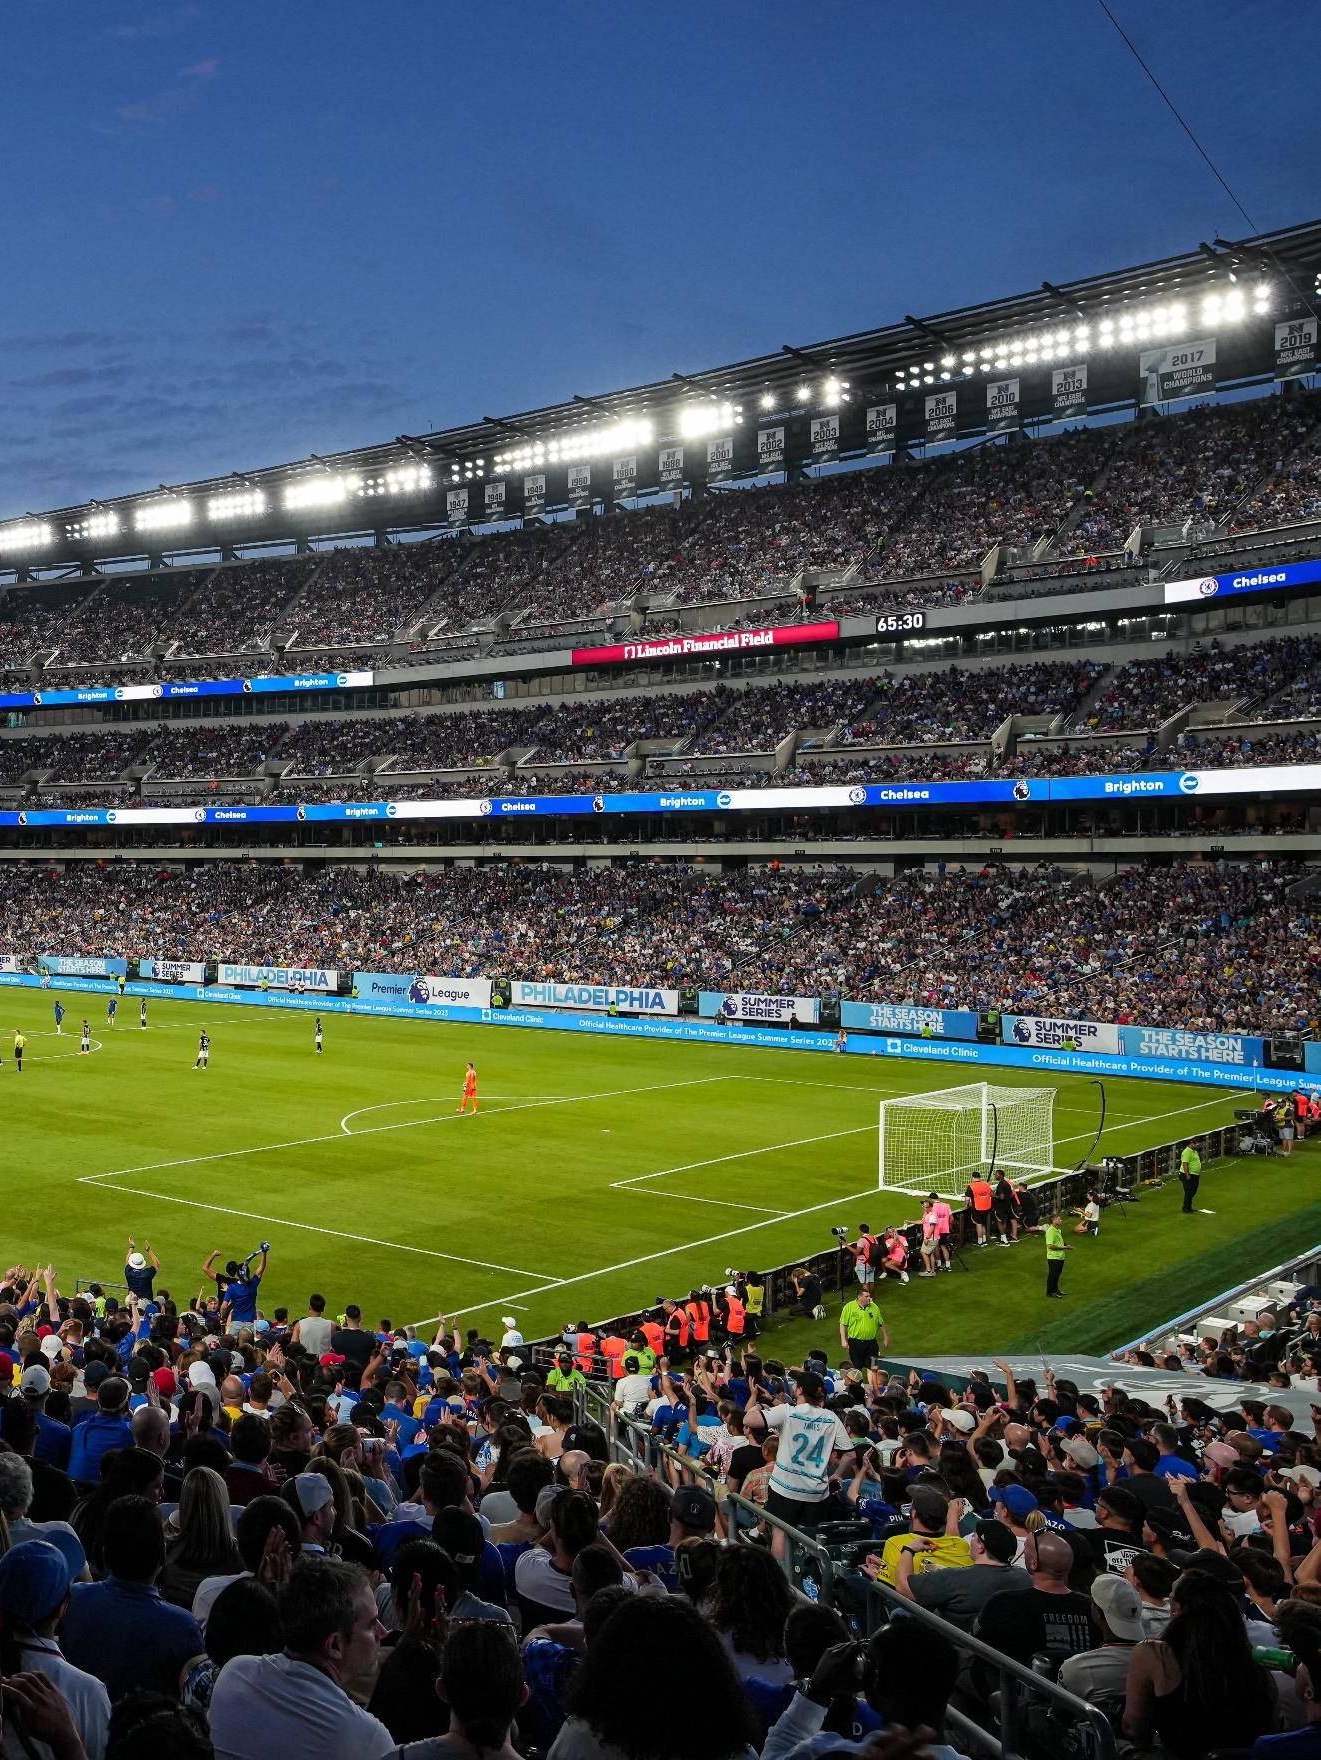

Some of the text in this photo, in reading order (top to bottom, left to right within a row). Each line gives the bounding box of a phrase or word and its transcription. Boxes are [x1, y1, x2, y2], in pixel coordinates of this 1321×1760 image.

[1280, 332, 1311, 348] 2019
[1172, 350, 1204, 366] 2017
[1277, 352, 1314, 364] CHAMPIONS
[1280, 350, 1292, 358] NFC
[1173, 368, 1202, 380] WORLD
[1056, 380, 1082, 393] 2013
[1164, 373, 1212, 390] CHAMPIONS
[991, 392, 1015, 405] 2010
[1054, 397, 1085, 408] CHAMPIONS
[928, 406, 954, 418] 2006
[869, 417, 893, 429] 2004
[814, 428, 836, 440] 2003
[761, 440, 782, 451] 2002
[710, 449, 730, 461] 2001
[527, 485, 544, 495] 1949
[488, 493, 503, 501] 1948
[1233, 572, 1286, 588] Chelsea
[877, 614, 923, 632] 65:30
[637, 631, 774, 658] Lincoln Financial Field
[78, 692, 107, 701] Brighton
[294, 679, 328, 687] Brighton
[67, 814, 98, 822] Brighton
[346, 808, 378, 817] Brighton
[502, 802, 536, 811] Chelsea
[660, 797, 705, 808] Brighton
[880, 790, 929, 800] Chelsea
[1104, 781, 1163, 794] Brighton
[162, 963, 191, 972] SUMMER
[224, 967, 328, 986] PHILADELPHIA
[371, 982, 470, 1002] Premier League
[520, 984, 666, 1010] PHILADELPHIA
[286, 998, 312, 1006] Healthcare
[741, 997, 795, 1009] SUMMER
[492, 1012, 544, 1023] Cleveland Clinic
[741, 1007, 782, 1019] SERIES
[871, 1006, 943, 1022] THE SEASON
[870, 1018, 911, 1030] STARTS
[1035, 1020, 1098, 1037] SUMMER
[579, 1020, 604, 1028] Official
[606, 1022, 642, 1032] Healthcare
[644, 1024, 673, 1034] Provider
[684, 1027, 697, 1036] The
[699, 1029, 726, 1038] Premier
[728, 1031, 755, 1041] League
[758, 1033, 788, 1044] Summer
[790, 1035, 814, 1045] Series
[1142, 1030, 1242, 1052] THE SEASON
[904, 1043, 978, 1058] Cleveland Clinic
[1140, 1042, 1244, 1064] STARTS HERE
[1032, 1054, 1296, 1088] Official Healthcare Provider of The Premier League
[791, 1433, 825, 1468] 24
[1042, 1613, 1088, 1624] FREEDOM
